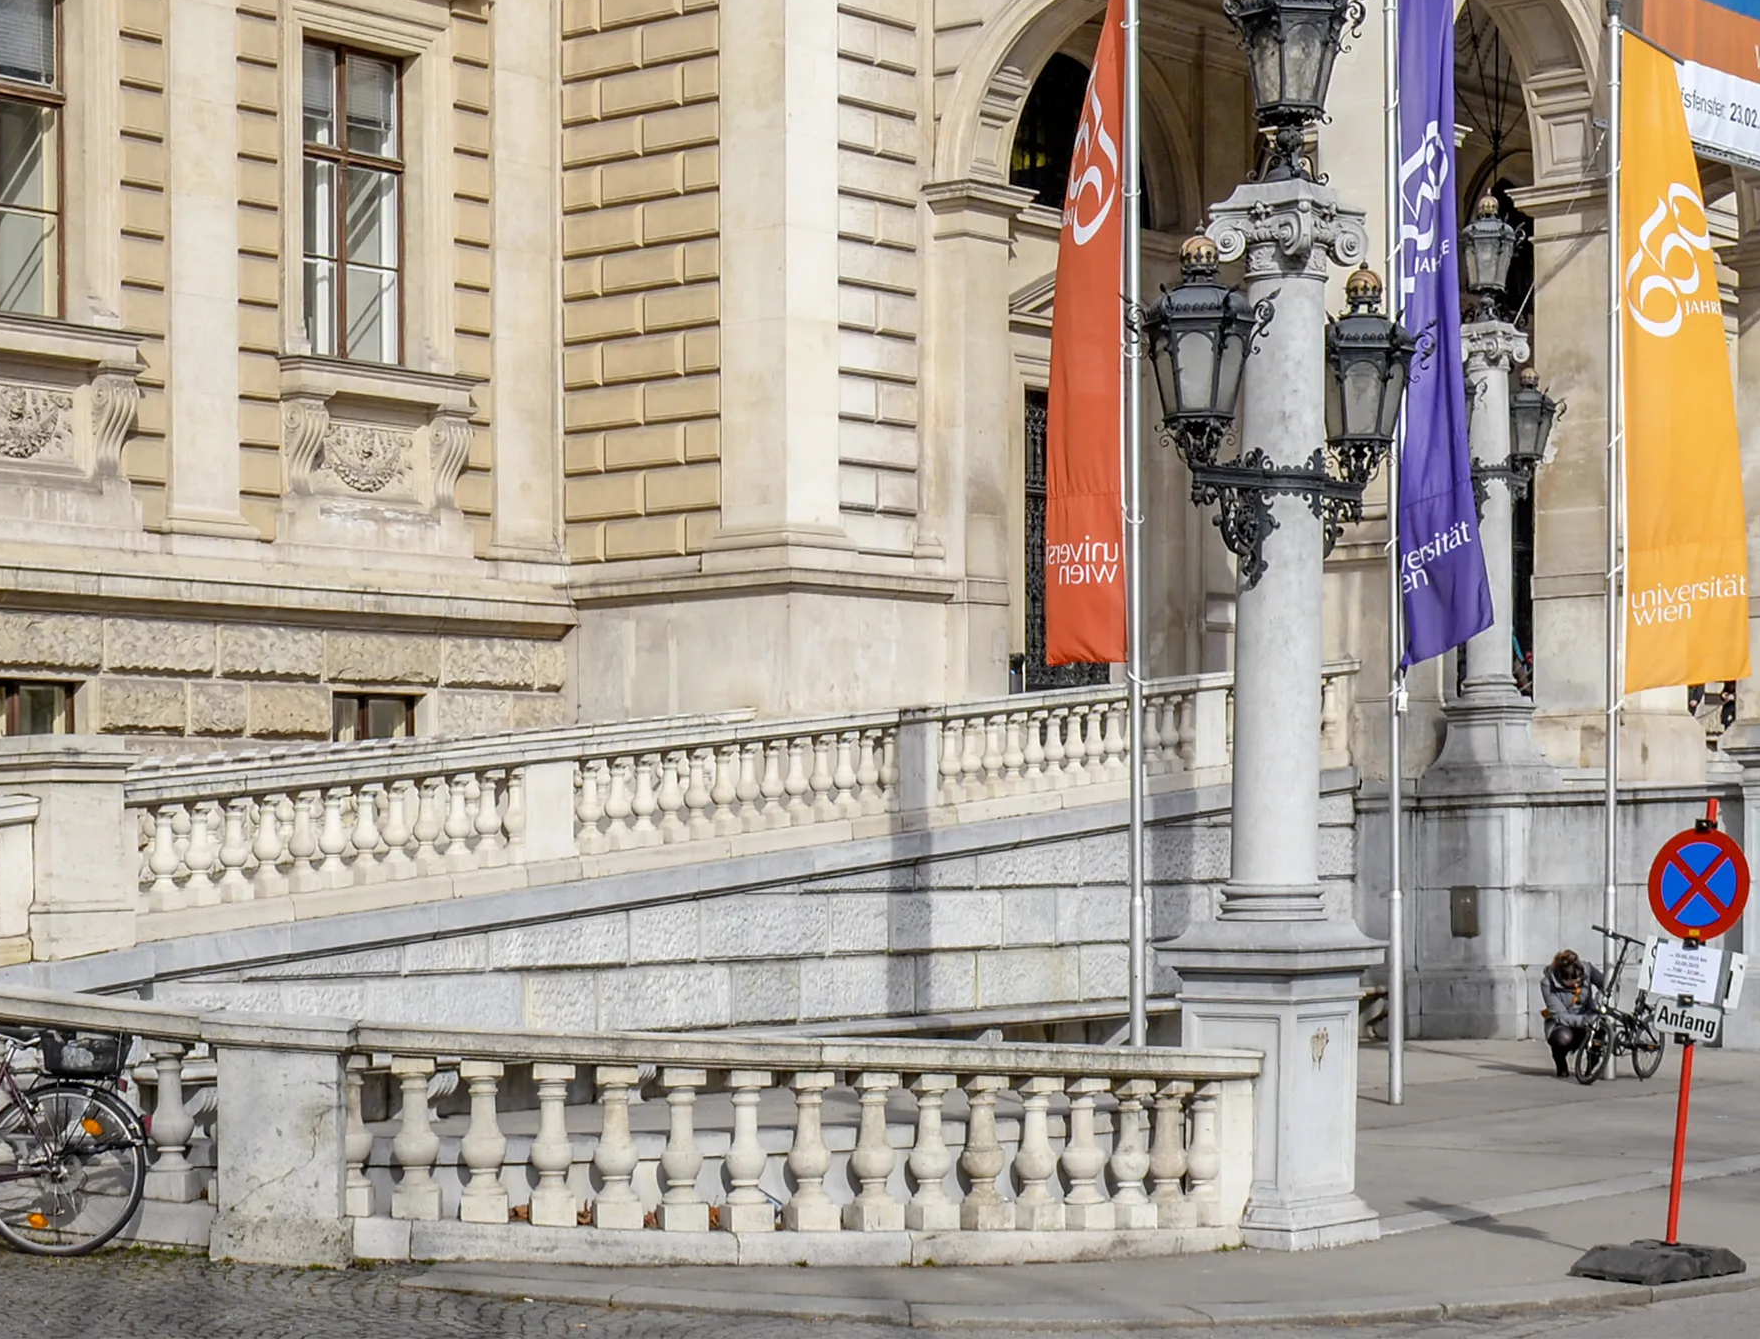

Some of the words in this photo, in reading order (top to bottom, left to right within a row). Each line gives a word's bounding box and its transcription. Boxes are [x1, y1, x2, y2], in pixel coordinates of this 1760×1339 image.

[1625, 182, 1711, 338] 650
[1631, 573, 1747, 609] universität
[1632, 602, 1692, 626] wien
[1657, 1004, 1716, 1039] Anfang
